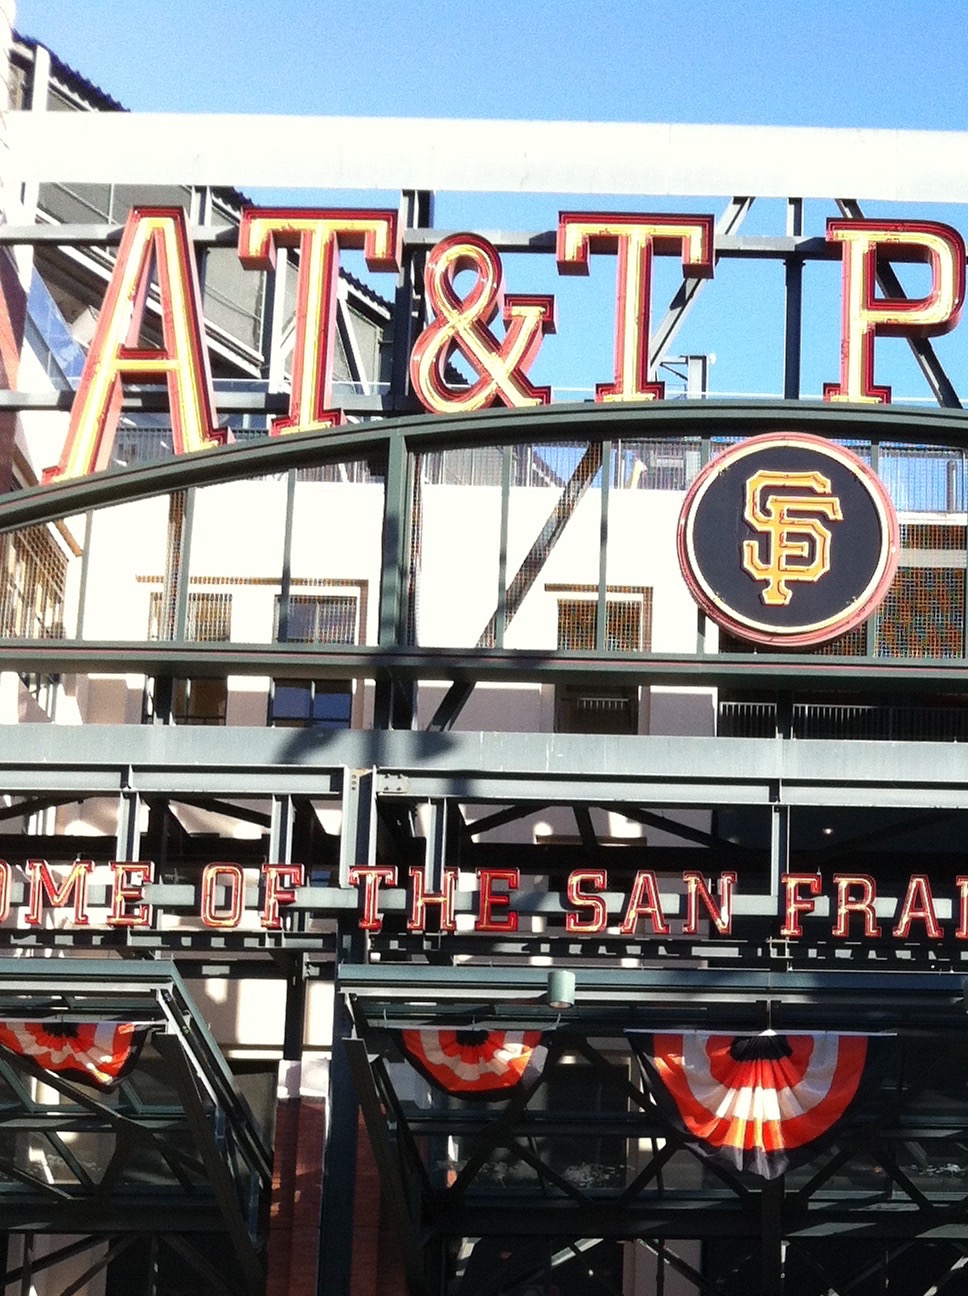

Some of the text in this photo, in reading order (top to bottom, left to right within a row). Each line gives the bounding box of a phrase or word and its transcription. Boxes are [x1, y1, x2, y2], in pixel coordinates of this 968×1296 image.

[41, 206, 714, 485] AT&T
[201, 861, 304, 928] OF
[348, 865, 520, 931] THE
[566, 868, 737, 935] SAN
